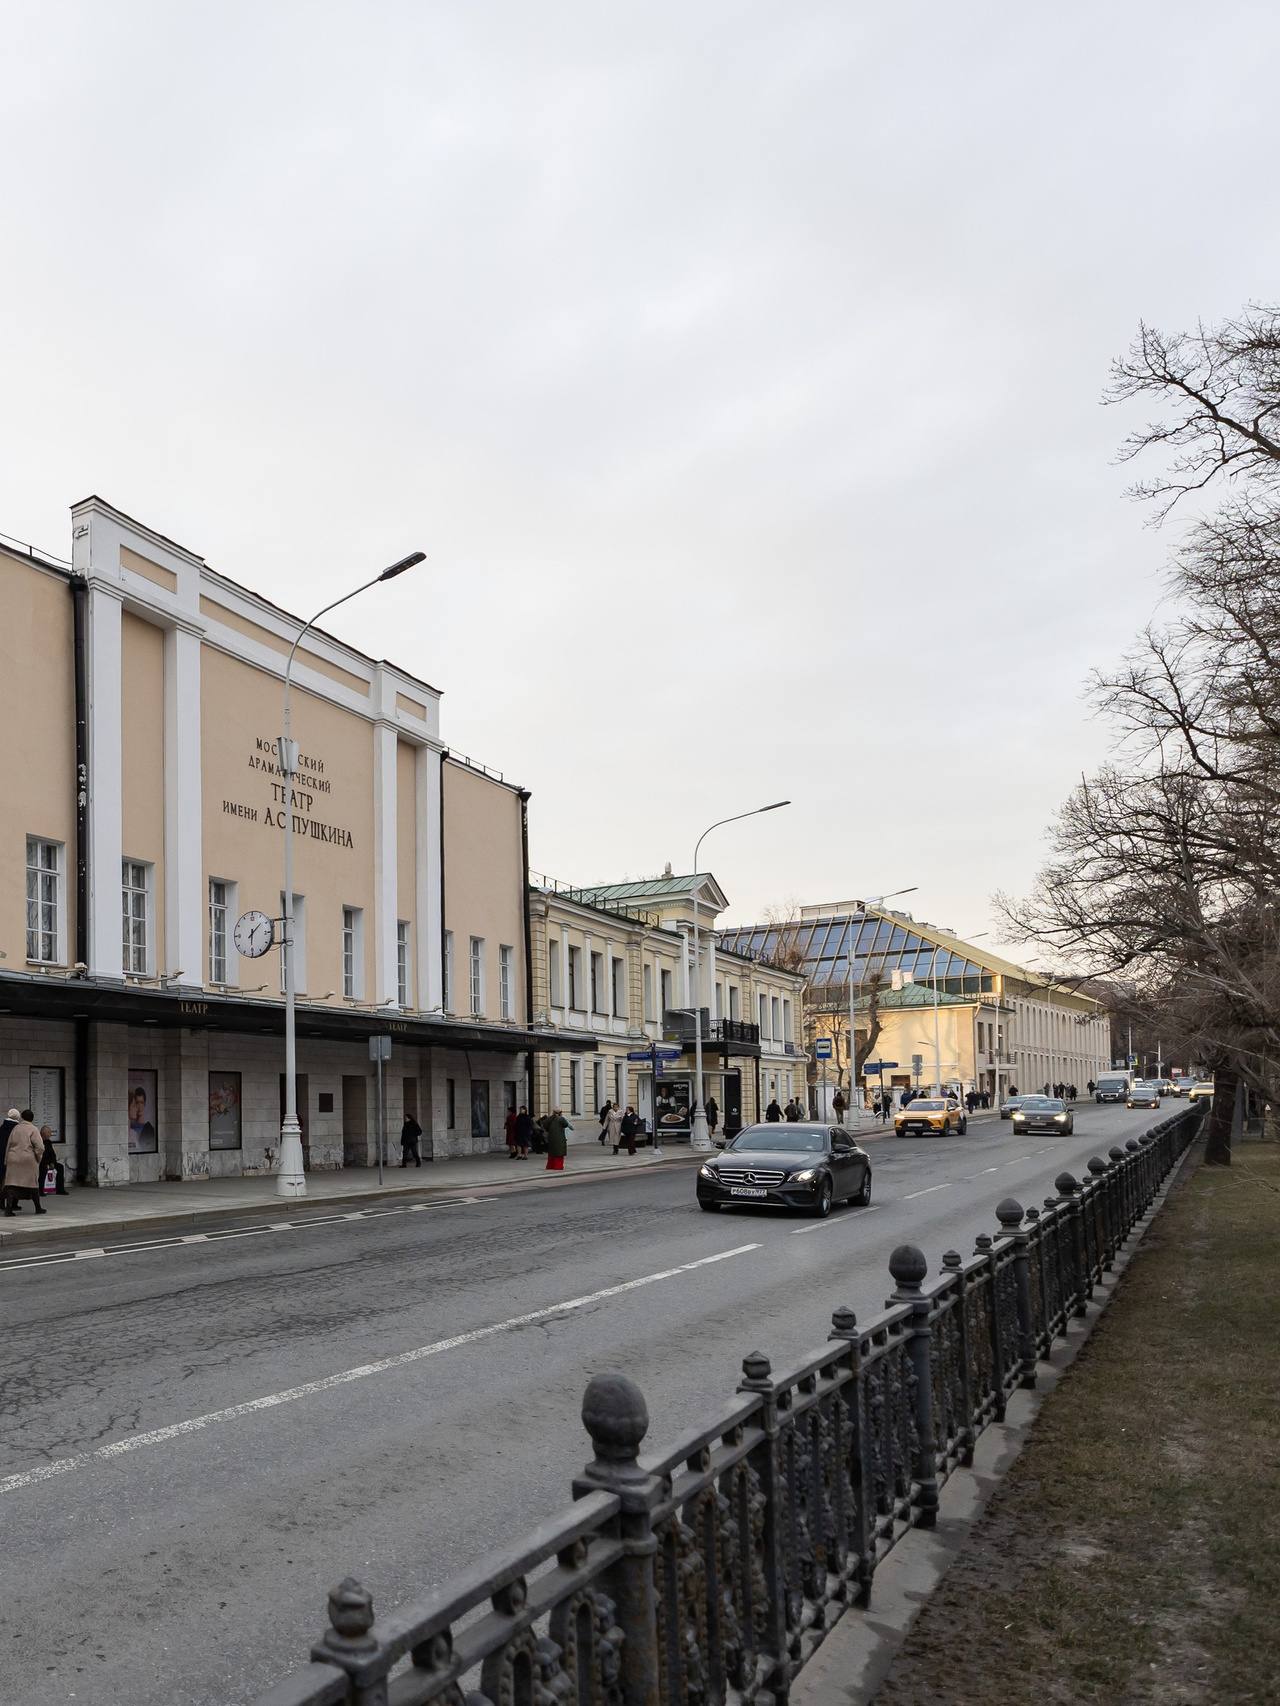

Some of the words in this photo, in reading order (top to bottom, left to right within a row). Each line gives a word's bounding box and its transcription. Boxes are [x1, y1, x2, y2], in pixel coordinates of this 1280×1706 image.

[256, 737, 324, 773] МОССКИЙ
[270, 782, 314, 812] ТЕАТР
[222, 800, 258, 822] ИМЕНИ
[179, 1001, 209, 1015] ТЕАТР
[388, 1021, 408, 1032] ТЕАТР
